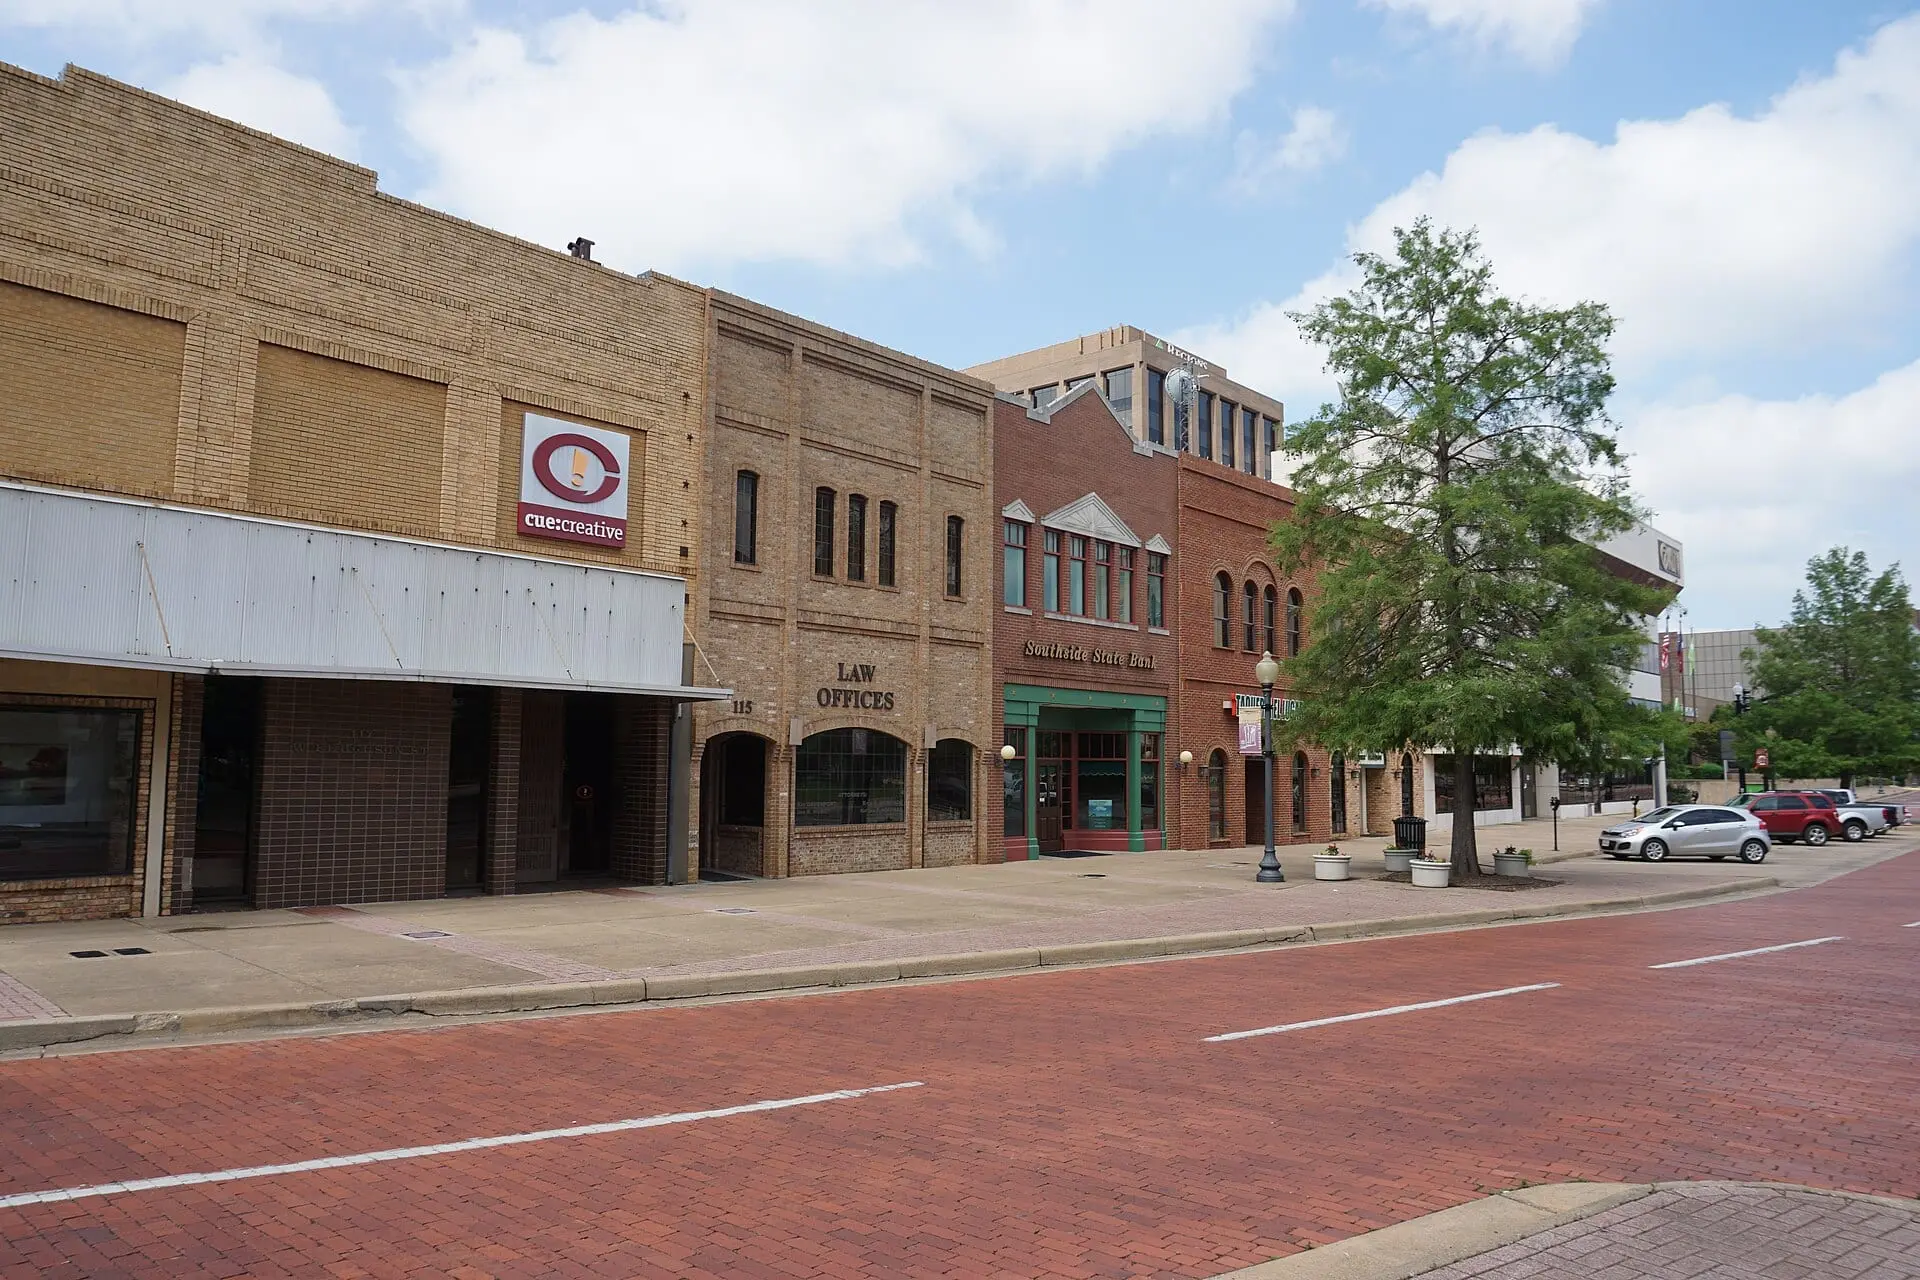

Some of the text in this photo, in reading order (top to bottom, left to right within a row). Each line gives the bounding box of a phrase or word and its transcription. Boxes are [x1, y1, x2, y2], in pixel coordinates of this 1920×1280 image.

[524, 513, 623, 540] cue:creative
[1025, 639, 1157, 669] Southside State Bank
[837, 662, 876, 682] LAW
[732, 700, 753, 714] 115
[816, 687, 894, 710] OFFICES
